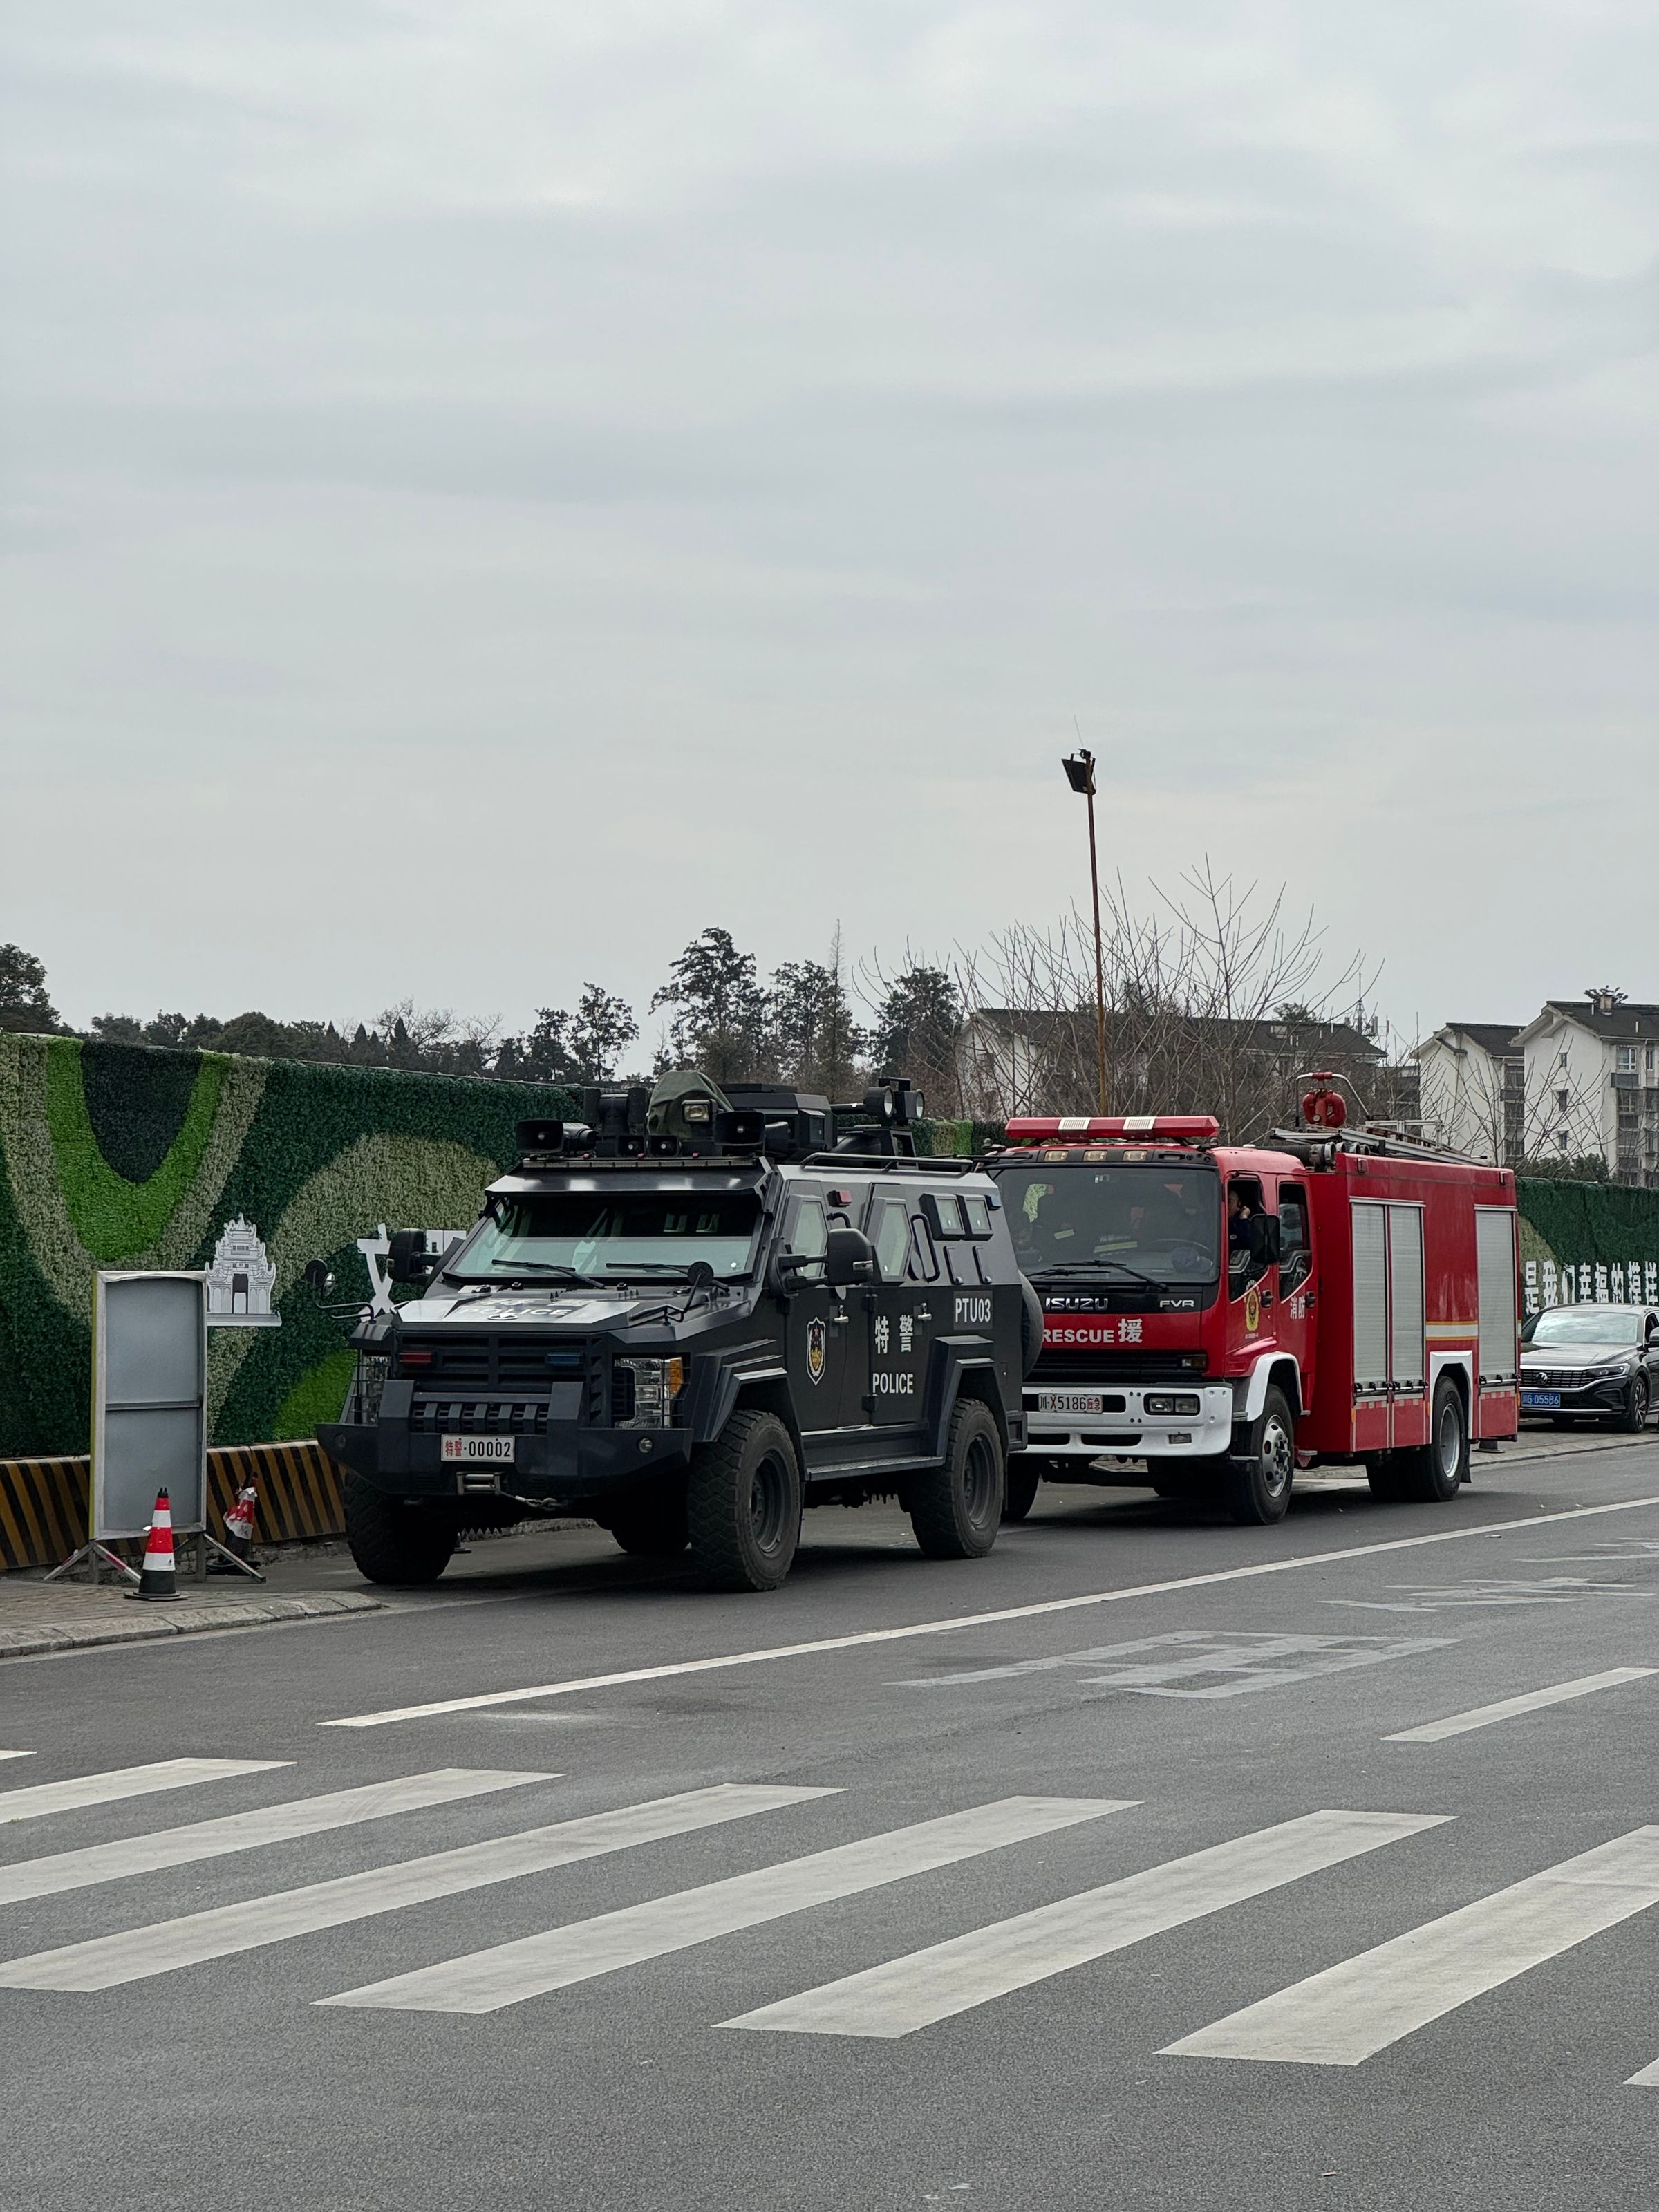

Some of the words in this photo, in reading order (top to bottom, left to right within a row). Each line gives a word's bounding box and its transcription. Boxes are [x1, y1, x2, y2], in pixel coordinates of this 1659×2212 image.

[458, 1308, 572, 1316] POLICE
[955, 1298, 991, 1323] PTU03
[1045, 1297, 1108, 1311] ISUZU
[1159, 1300, 1194, 1308] FVR
[1290, 1296, 1306, 1320] 消防
[874, 1315, 913, 1355] 特警
[1042, 1329, 1114, 1343] RESCUE
[1118, 1318, 1143, 1343] 援
[872, 1373, 914, 1394] POLICE
